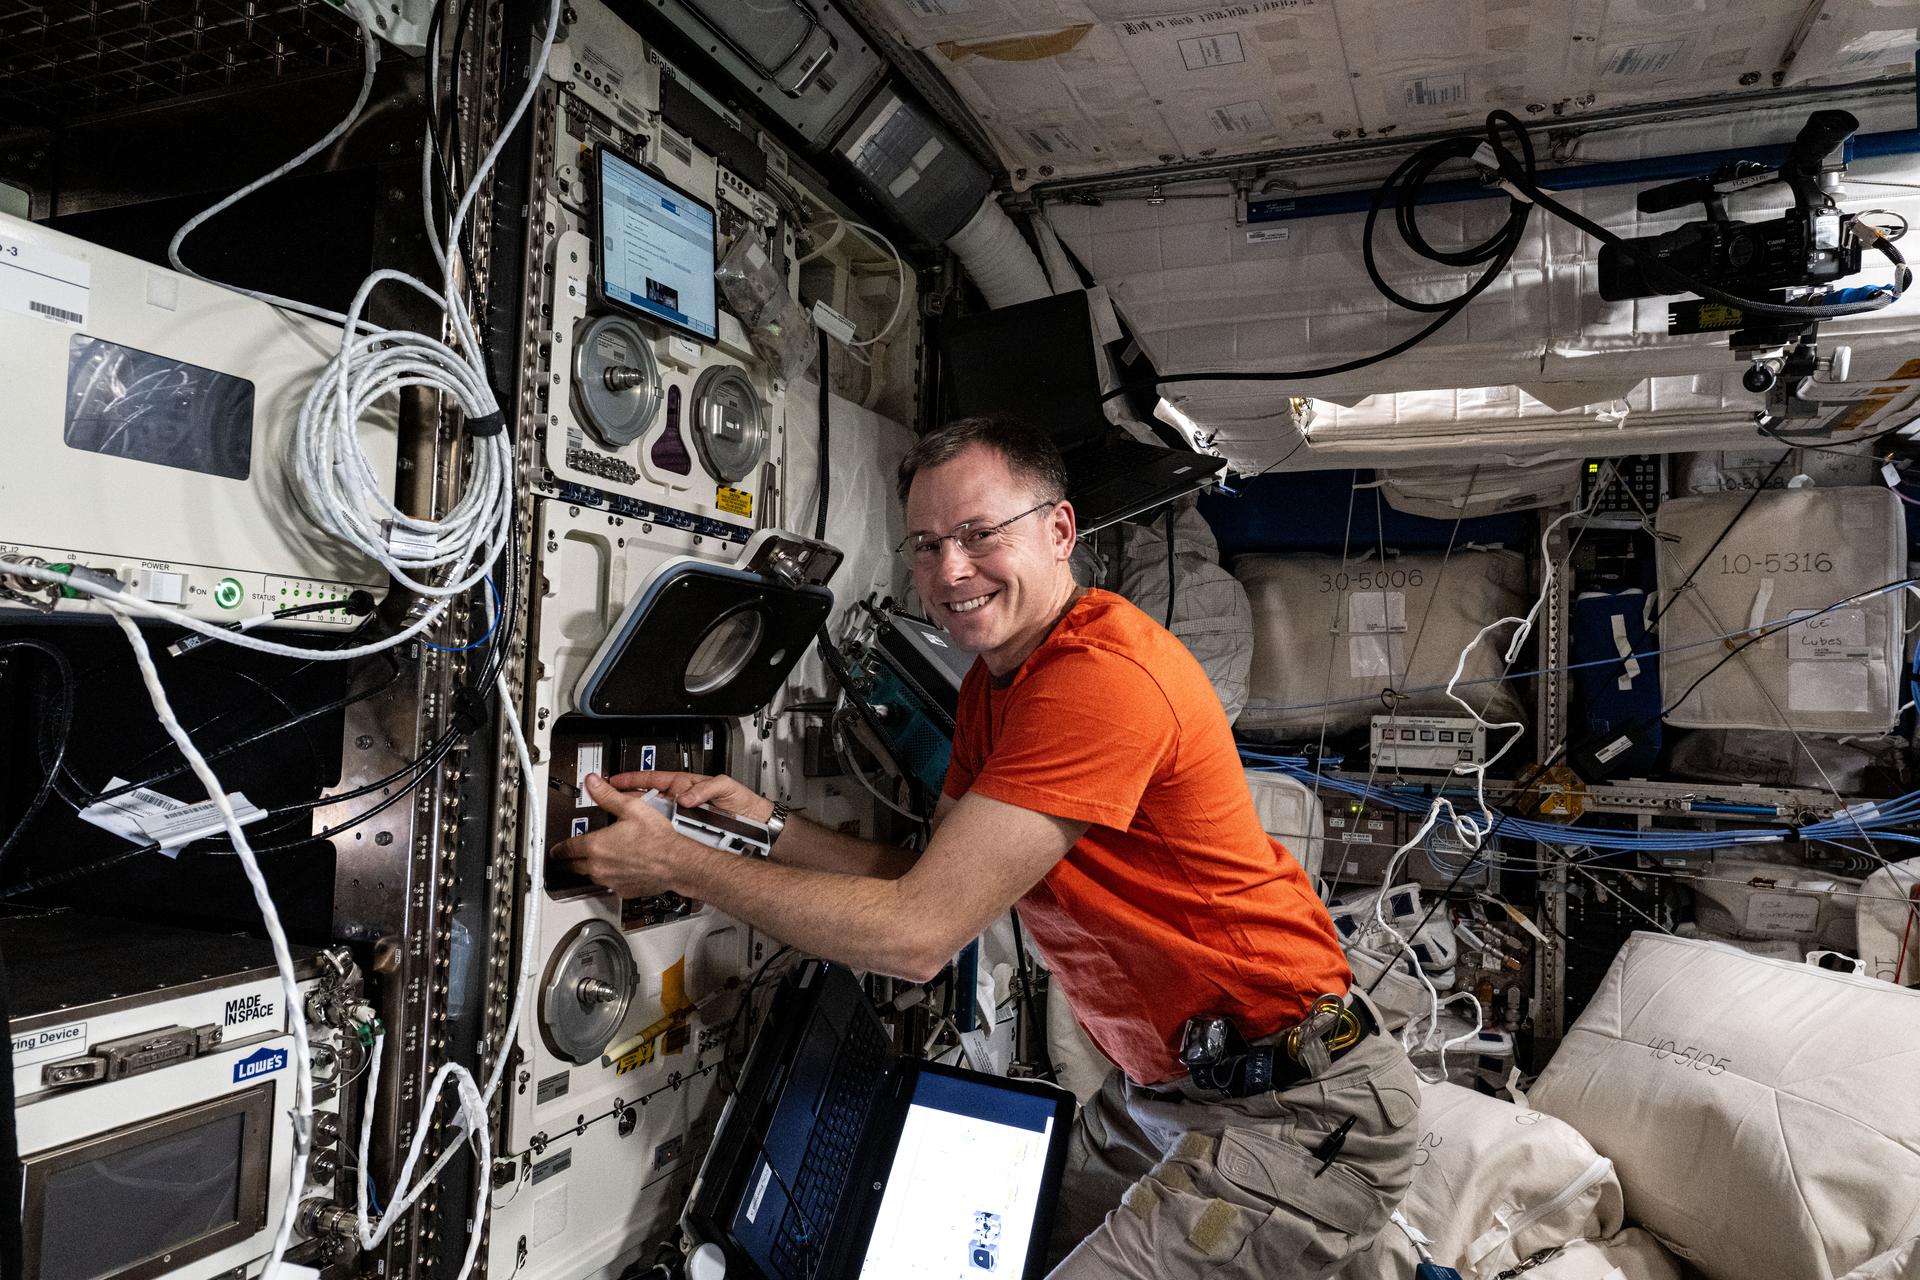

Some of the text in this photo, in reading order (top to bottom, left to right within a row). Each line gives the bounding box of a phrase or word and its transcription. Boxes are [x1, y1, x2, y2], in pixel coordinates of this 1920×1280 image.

[141, 561, 170, 571] POWER
[1720, 552, 1833, 575] 1.0-5316
[1319, 569, 1423, 593] 3.0-5006
[251, 592, 276, 602] STATUS
[1801, 636, 1842, 646] Cubes
[226, 994, 261, 1013] MADE
[238, 1003, 274, 1023] SPACE
[40, 1026, 79, 1045] Device
[239, 1054, 283, 1079] LOWE'S
